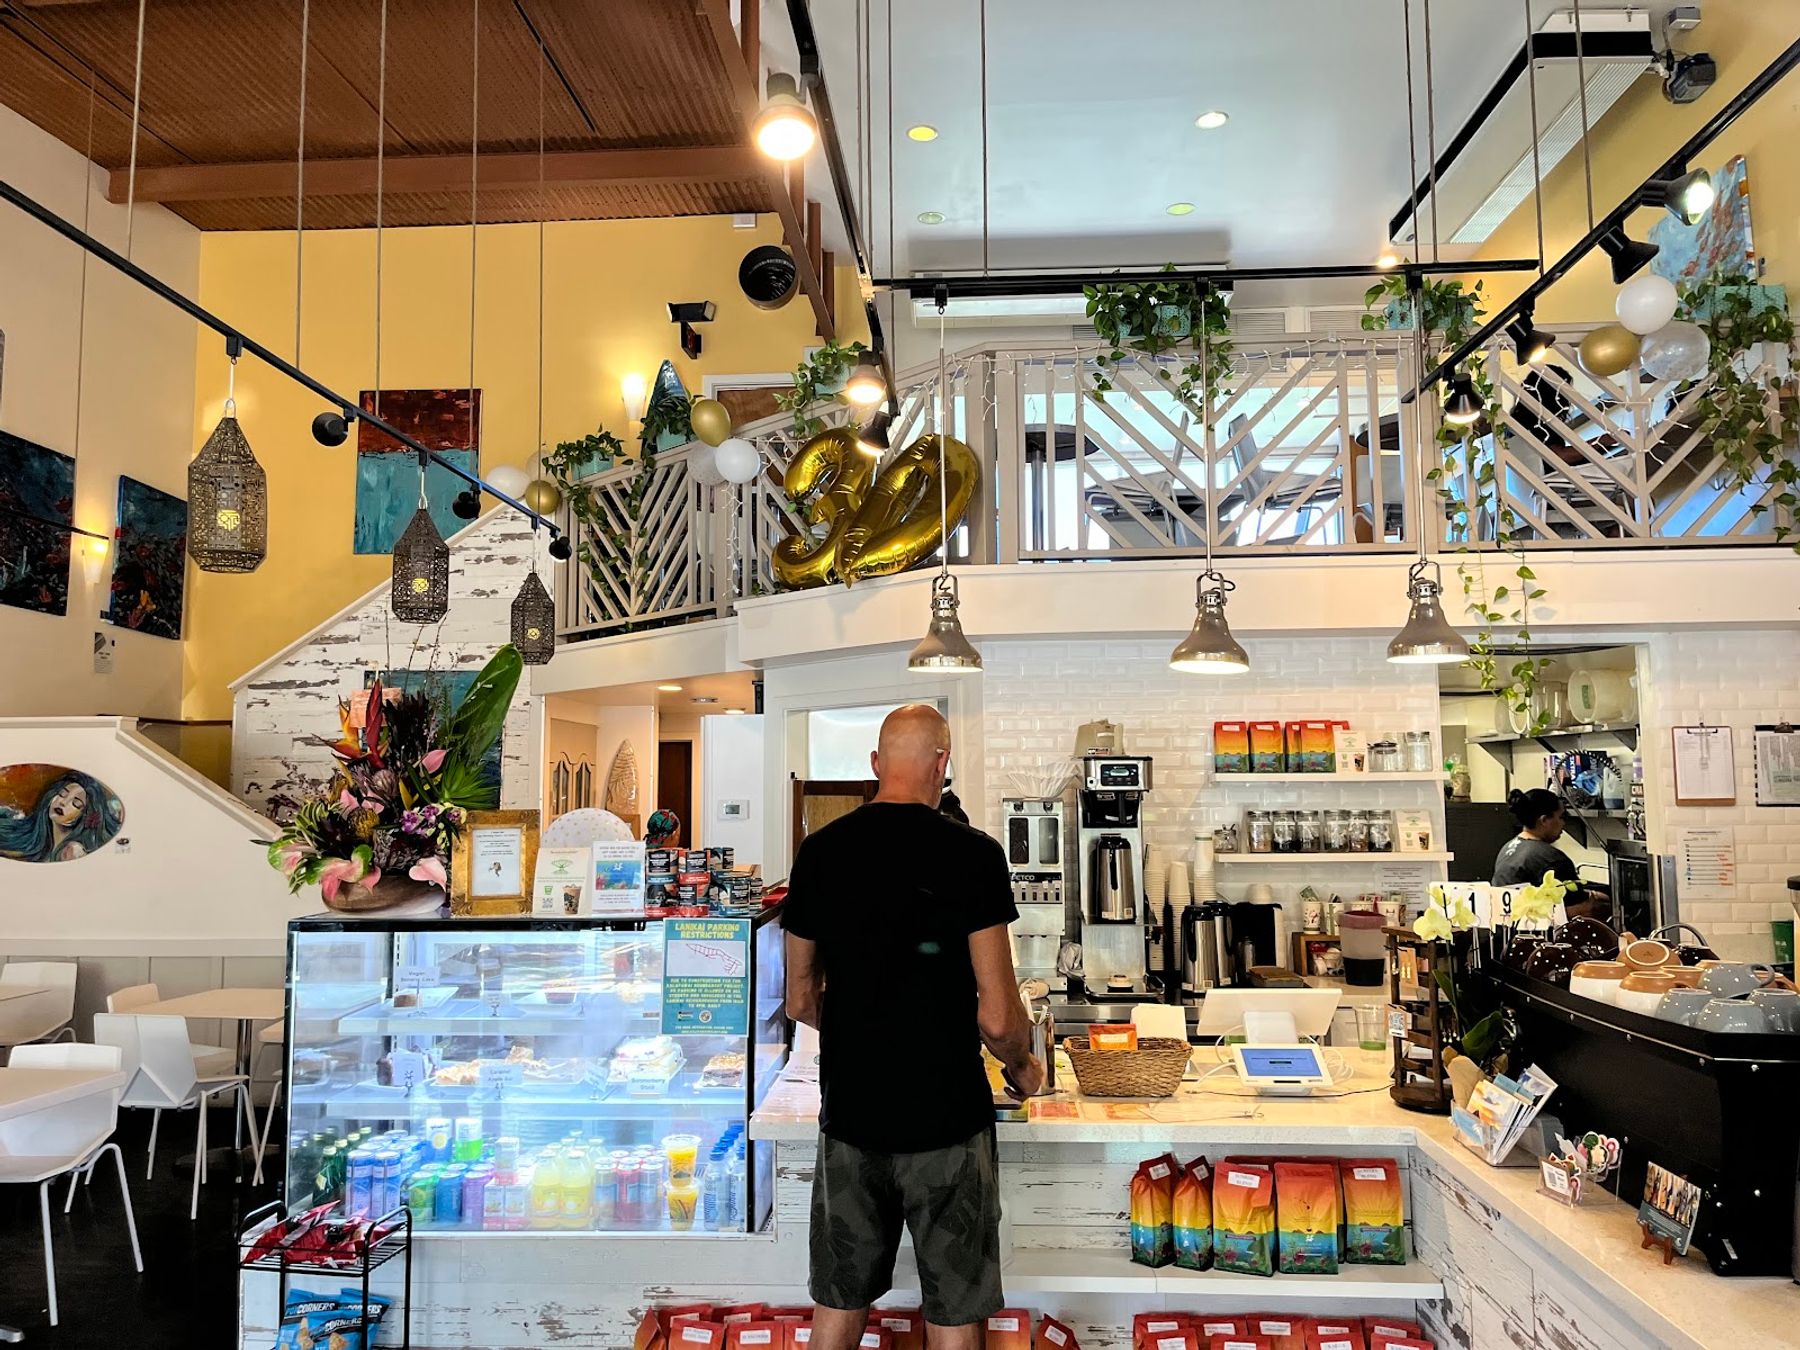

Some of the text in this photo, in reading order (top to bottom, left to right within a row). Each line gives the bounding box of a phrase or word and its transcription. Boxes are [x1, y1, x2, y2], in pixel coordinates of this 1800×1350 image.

[1501, 890, 1512, 914] 9
[675, 923, 705, 931] LANIKAI
[680, 931, 735, 939] RESTRICTIONS
